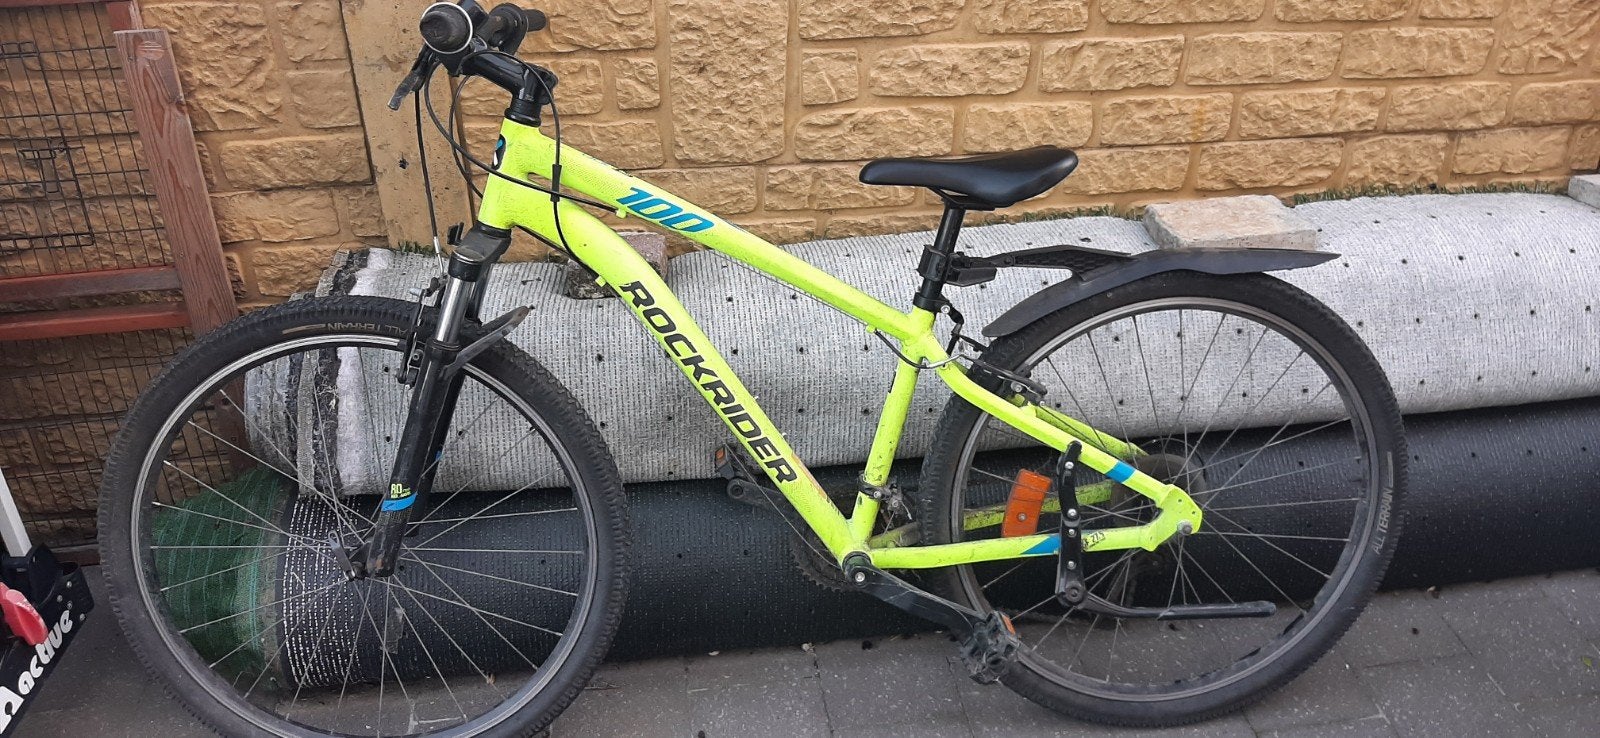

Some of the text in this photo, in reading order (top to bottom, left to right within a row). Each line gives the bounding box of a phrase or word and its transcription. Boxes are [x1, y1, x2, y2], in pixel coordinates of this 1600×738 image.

[616, 187, 715, 233] 100
[327, 322, 409, 336] ALL TERRAIN
[618, 280, 798, 484] ROCKRIDER
[1371, 487, 1393, 555] ALL TERRAIN
[18, 609, 74, 695] active
